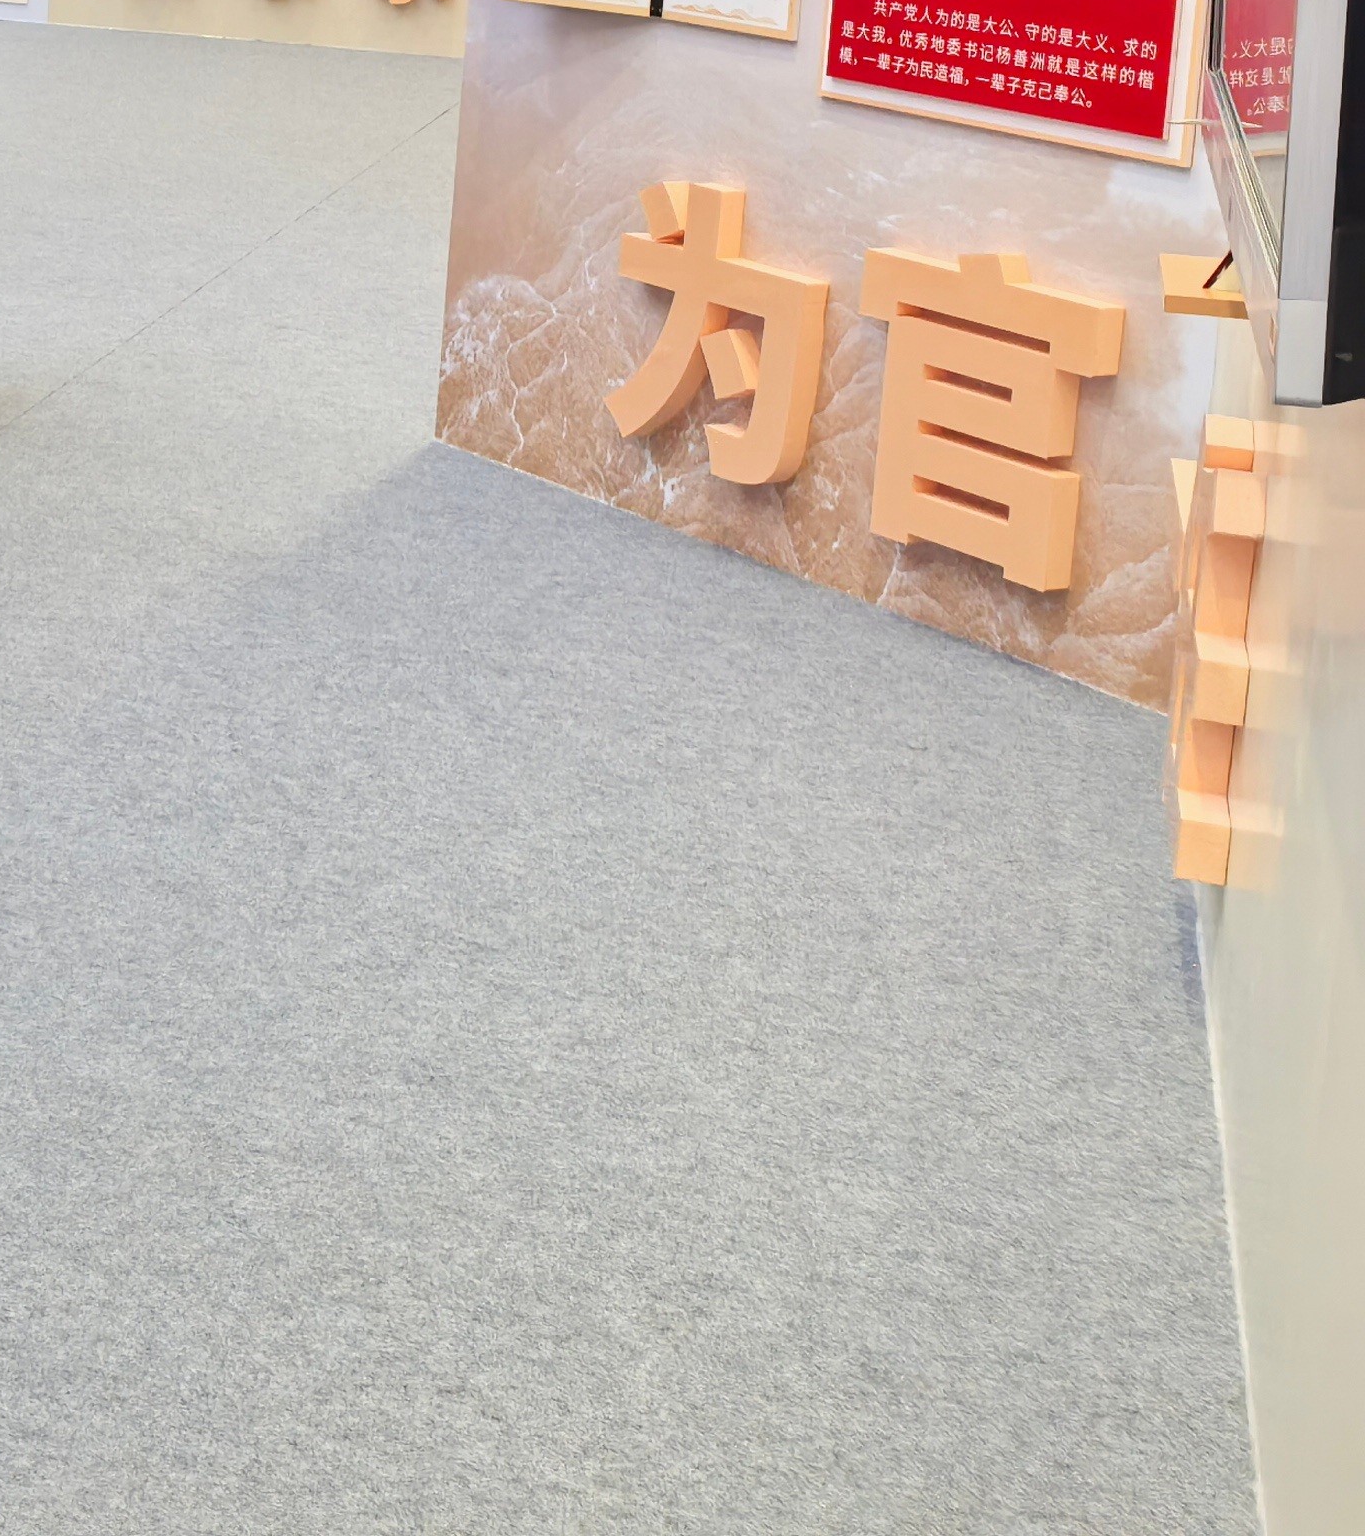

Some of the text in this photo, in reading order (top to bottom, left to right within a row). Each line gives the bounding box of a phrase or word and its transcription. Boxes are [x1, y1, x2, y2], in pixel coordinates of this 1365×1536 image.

[840, 21, 1154, 90] 是大我。优秀地委书记杨善洲就是这样的楷
[873, 0, 1157, 61] 共产党人为的是大公、守的是大义、求的
[839, 46, 1093, 109] 模，一辈子为民造福，一辈子克己奉公。
[603, 180, 1126, 592] 为官
